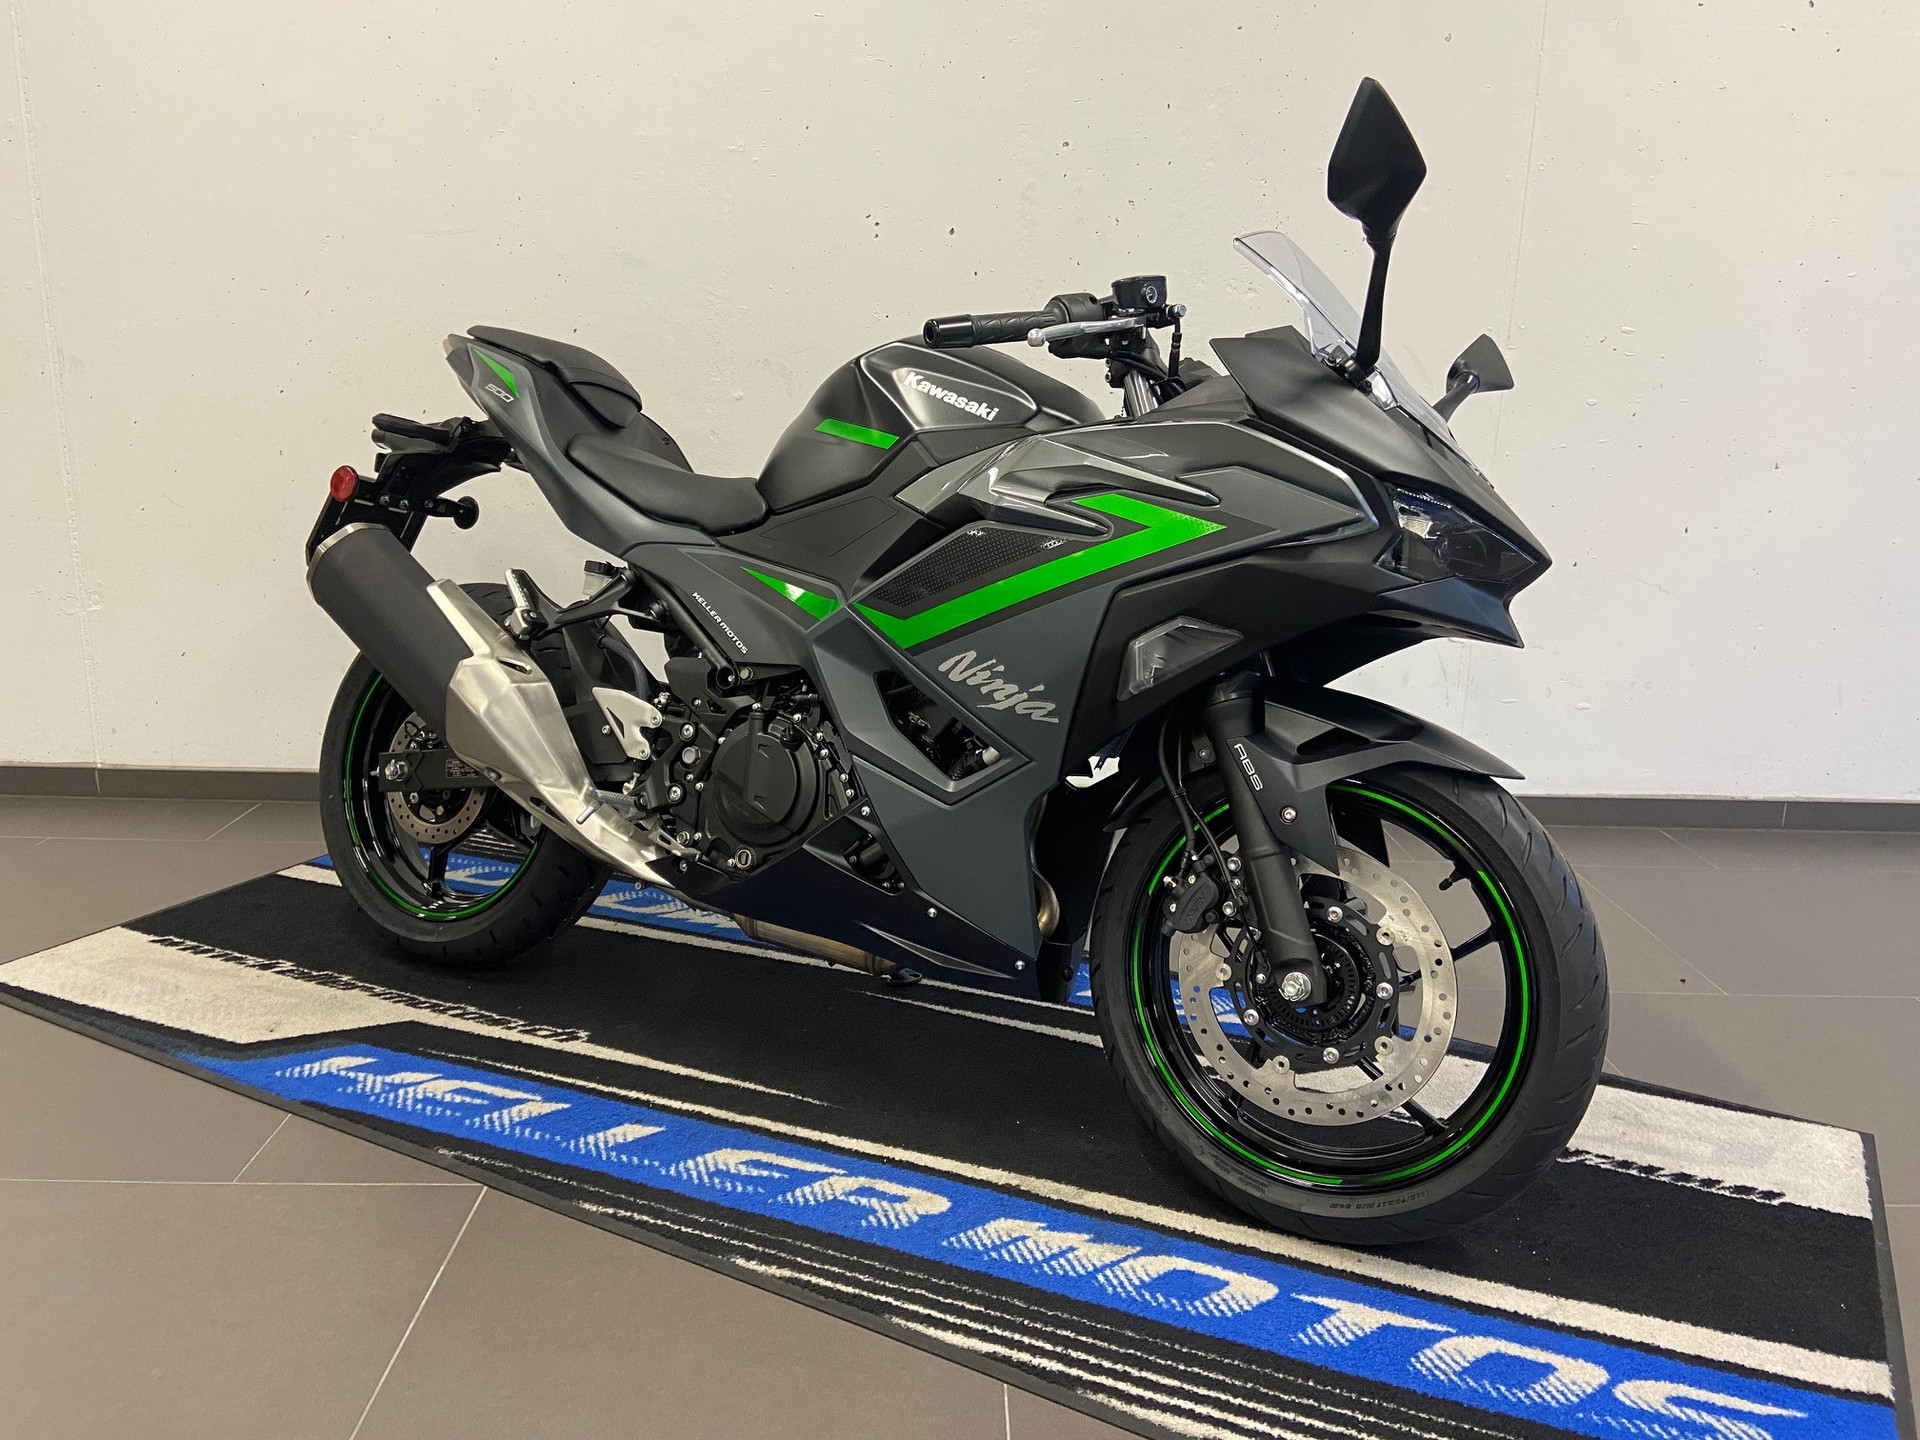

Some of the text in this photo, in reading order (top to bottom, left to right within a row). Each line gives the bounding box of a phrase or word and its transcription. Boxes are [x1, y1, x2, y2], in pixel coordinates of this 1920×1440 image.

[485, 383, 515, 403] 500
[903, 371, 1000, 421] Kawasaki
[692, 592, 748, 654] KELLER MOTOS
[938, 650, 1059, 723] Ninja
[1234, 743, 1263, 791] ABS
[942, 1217, 1809, 1440] MOTOS
